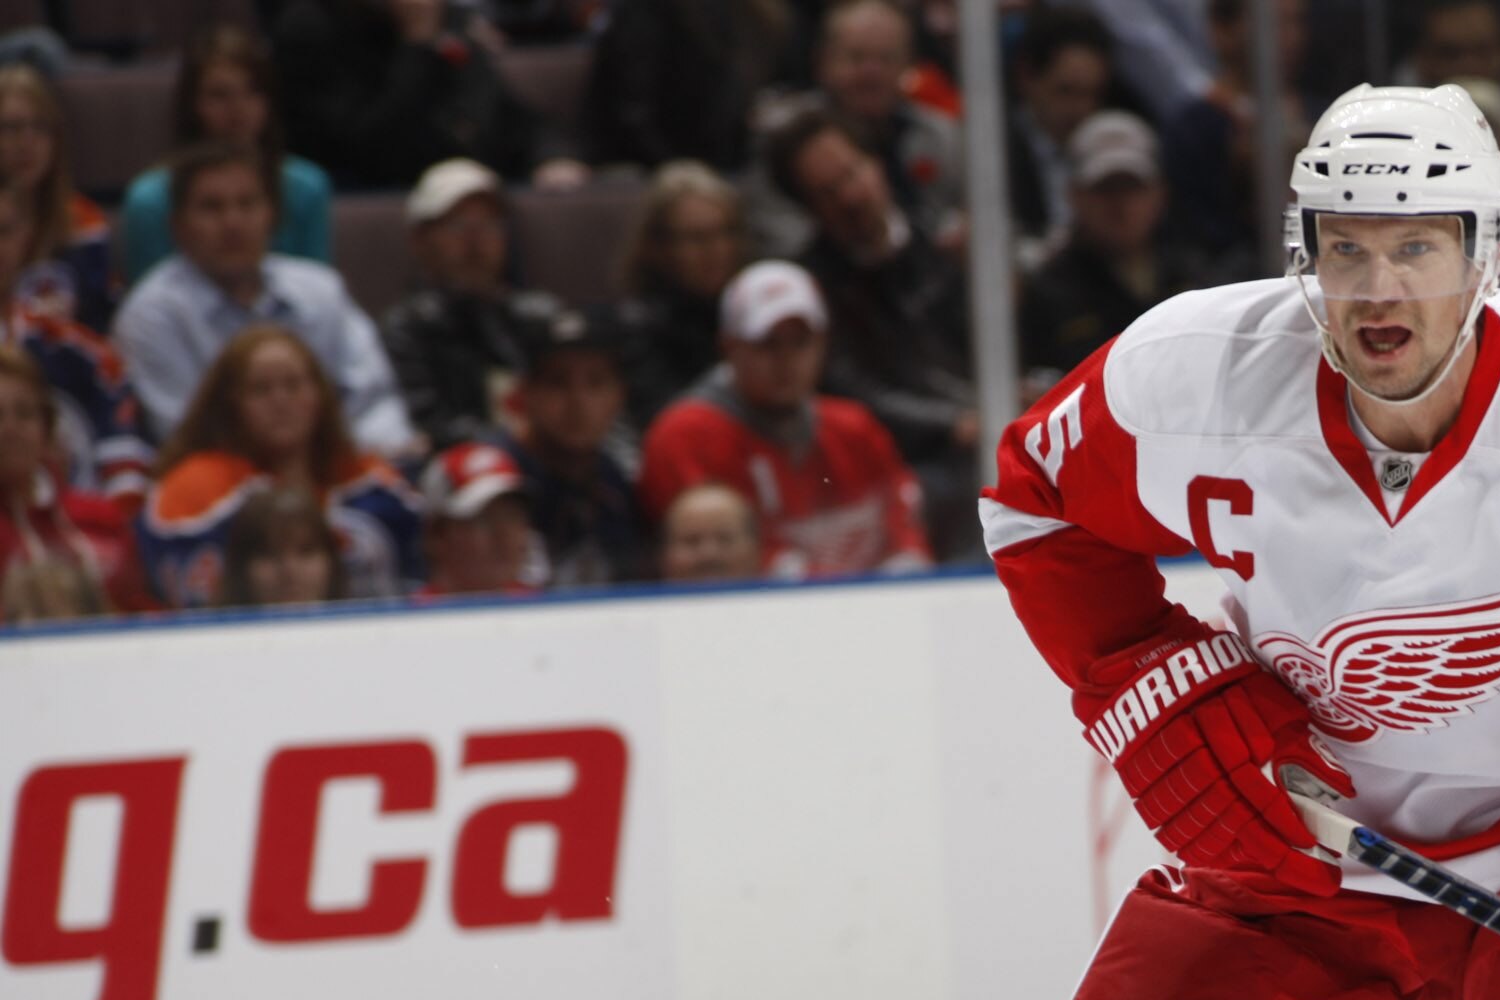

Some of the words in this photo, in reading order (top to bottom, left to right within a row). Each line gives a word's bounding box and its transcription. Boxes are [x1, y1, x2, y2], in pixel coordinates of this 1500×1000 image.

[1342, 164, 1411, 175] CCM
[1025, 376, 1087, 488] 5
[1186, 474, 1255, 582] C
